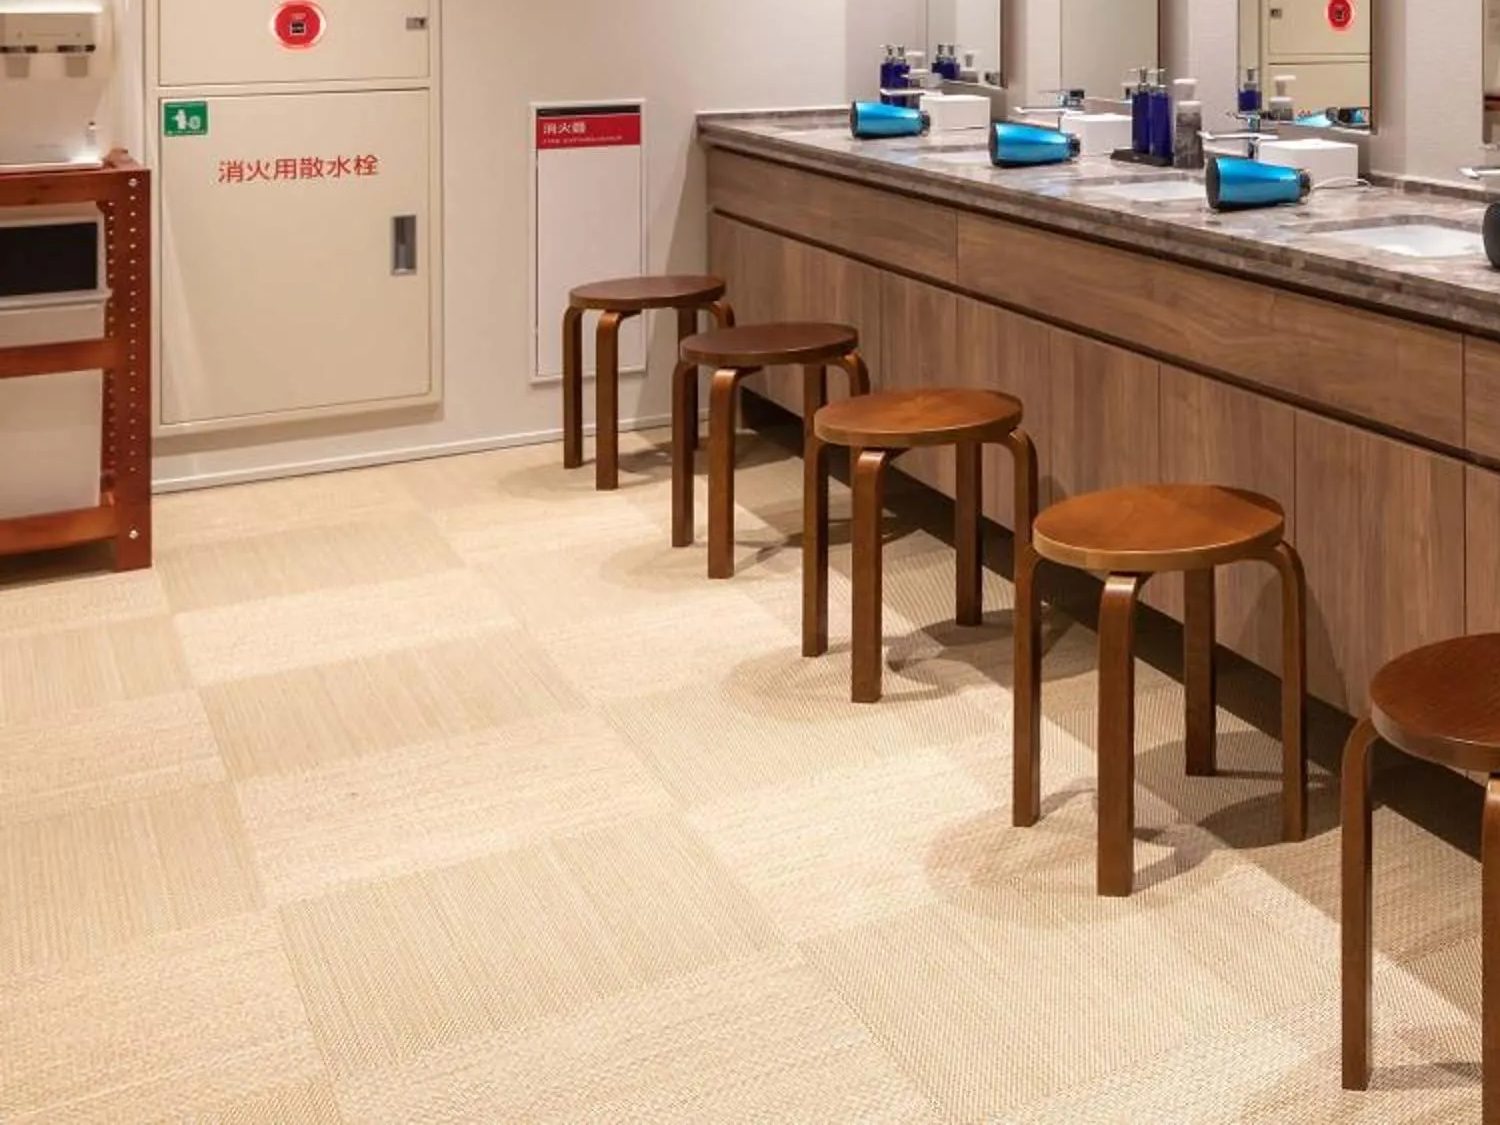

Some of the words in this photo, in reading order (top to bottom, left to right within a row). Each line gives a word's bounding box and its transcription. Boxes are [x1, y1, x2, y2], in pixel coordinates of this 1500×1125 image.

[217, 154, 380, 183] 消火用散水栓
